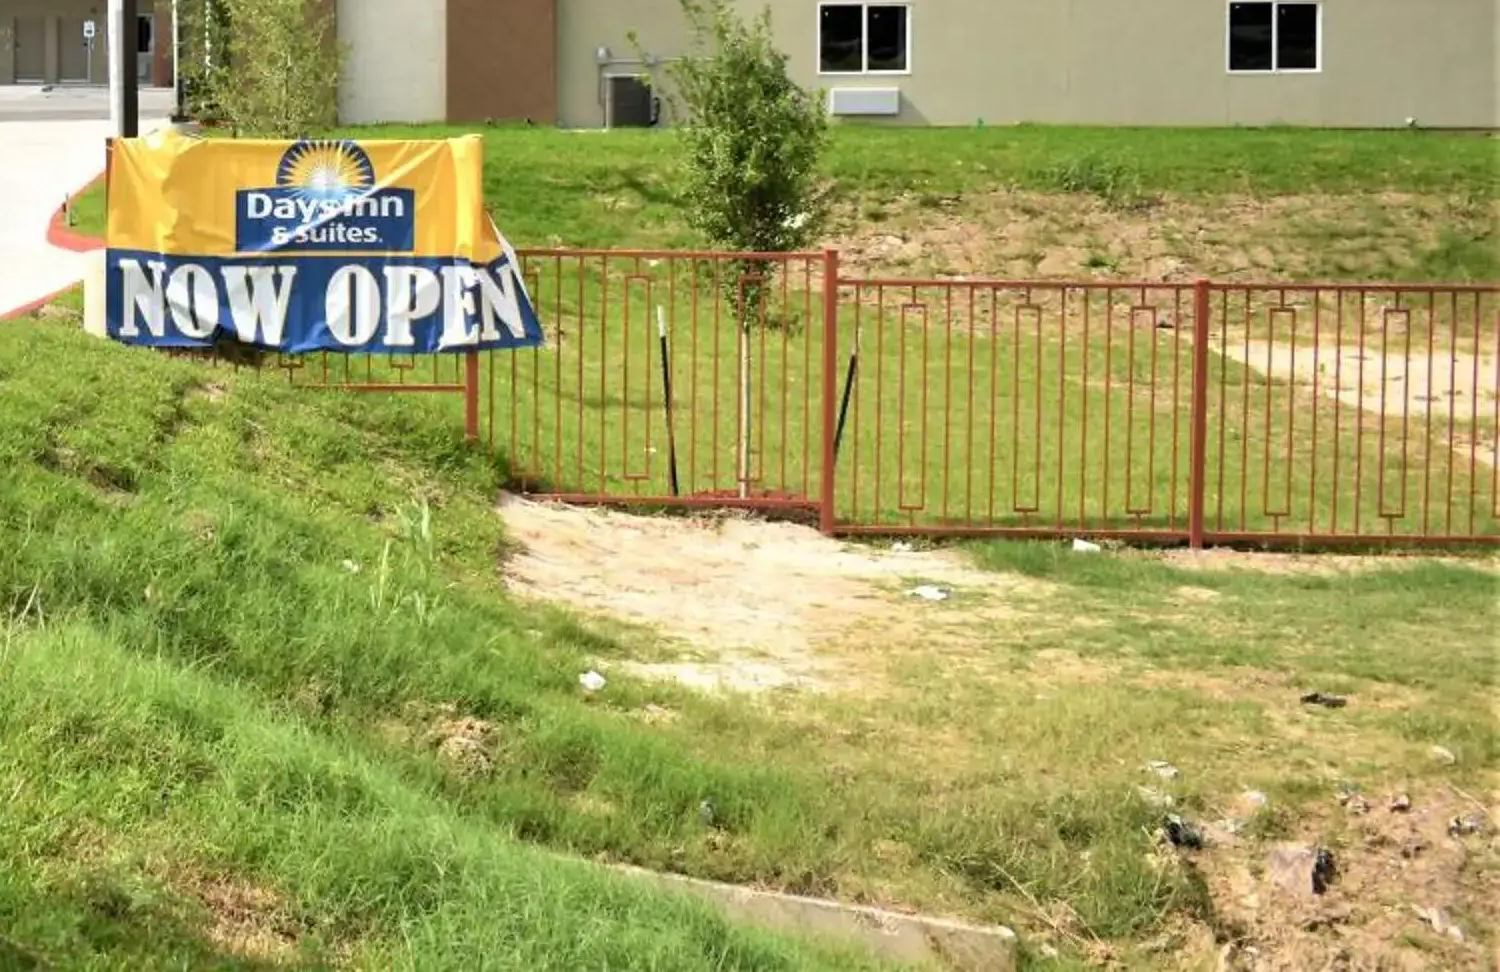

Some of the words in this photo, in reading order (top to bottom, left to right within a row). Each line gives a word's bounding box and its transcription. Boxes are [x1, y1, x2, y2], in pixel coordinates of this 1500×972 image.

[247, 193, 342, 223] Days
[271, 225, 292, 245] &
[118, 258, 298, 346] NOW
[325, 263, 525, 349] OPEN
